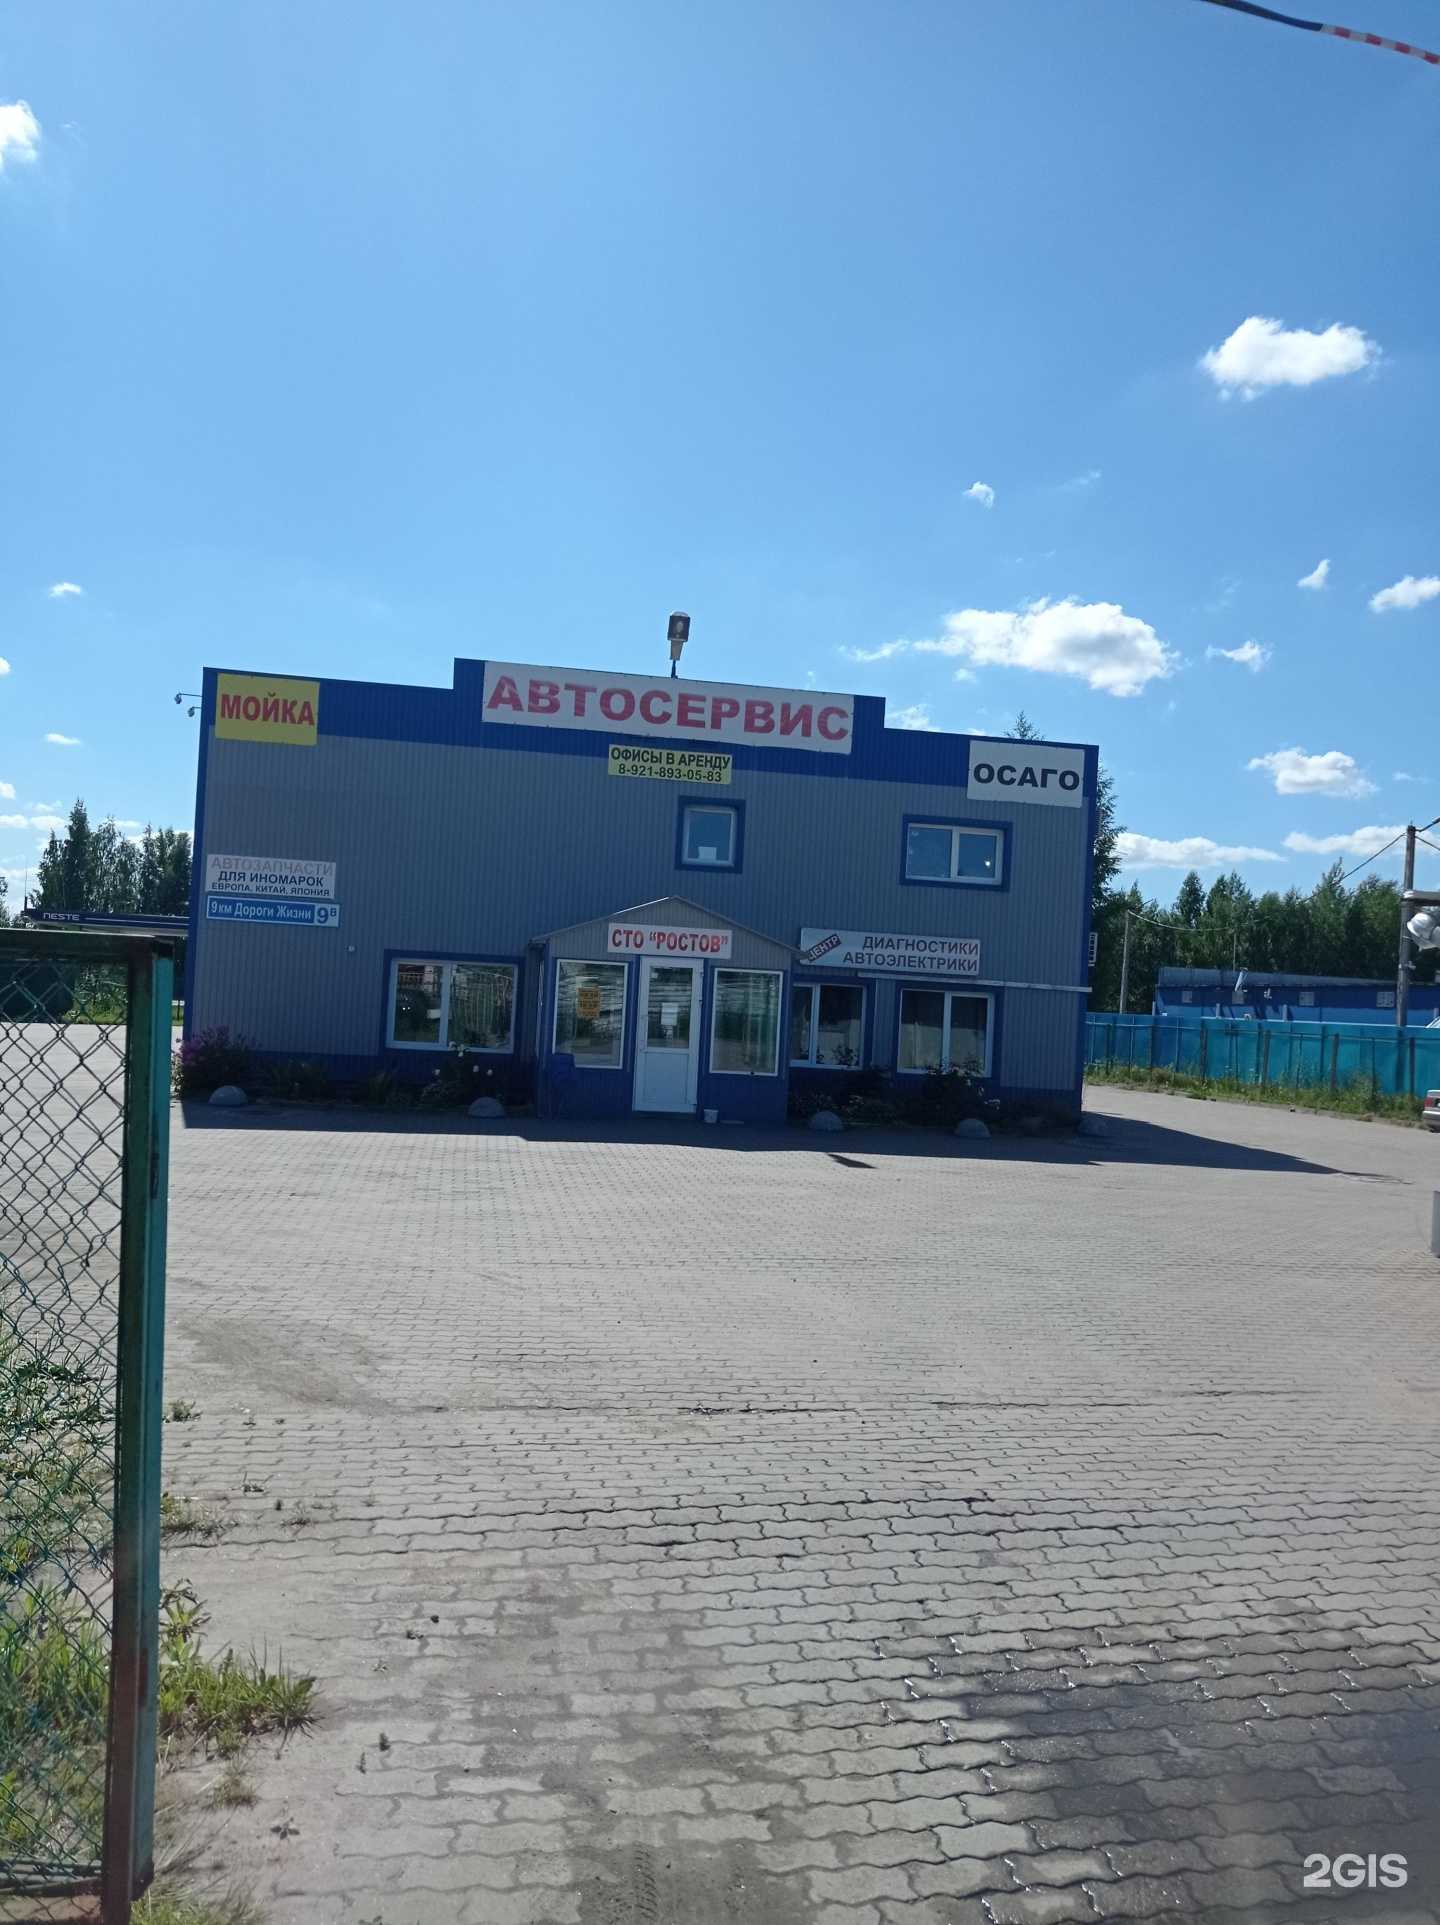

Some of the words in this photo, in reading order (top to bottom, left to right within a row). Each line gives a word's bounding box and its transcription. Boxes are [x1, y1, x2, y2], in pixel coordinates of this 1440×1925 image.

[220, 691, 315, 726] МОЙКА
[487, 675, 850, 741] АВТОСЕРВИС
[611, 747, 662, 764] ОФИСЫ
[666, 752, 675, 764] В
[678, 754, 730, 771] АРЕНДУ
[618, 763, 722, 782] 8-921-893-05-83
[973, 763, 1080, 791] ОСАГО
[211, 857, 333, 876] АВТОЗАПЧАСТИ
[218, 871, 246, 882] ДЛЯ
[250, 873, 324, 887] ИНОМАРОК
[290, 888, 330, 897] ЯПОНИЯ
[43, 912, 80, 921] NESTE
[211, 901, 218, 913] 9
[219, 904, 232, 913] км
[234, 902, 274, 918] Дороги
[276, 905, 312, 920] Жизни
[612, 929, 644, 949] СТО
[863, 936, 978, 955] ДИАГНОСТИКИ
[843, 952, 978, 972] АВТОЭЛЕКТРИКИ
